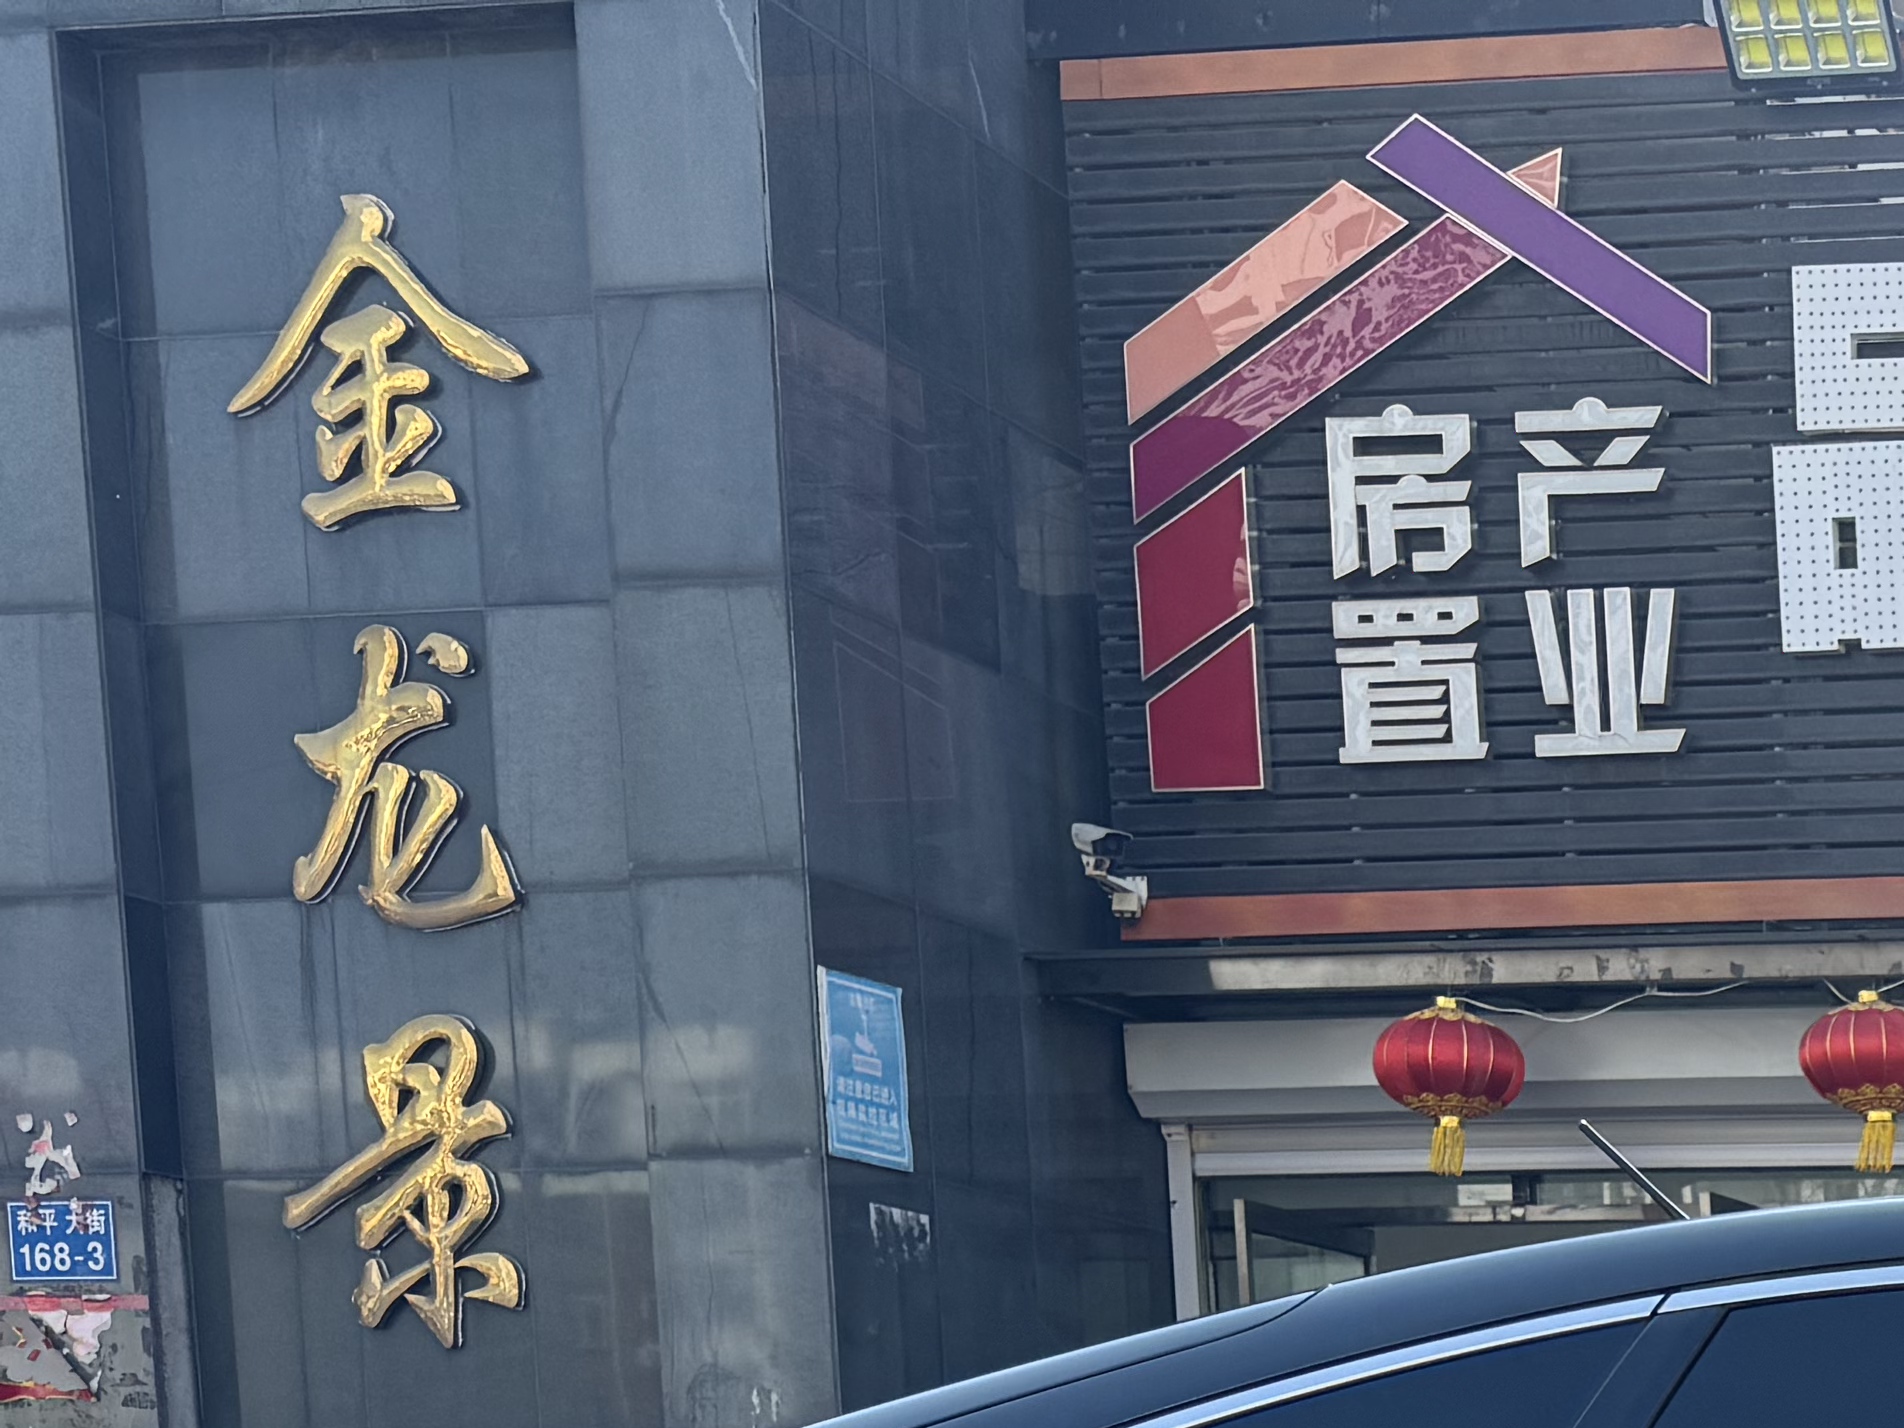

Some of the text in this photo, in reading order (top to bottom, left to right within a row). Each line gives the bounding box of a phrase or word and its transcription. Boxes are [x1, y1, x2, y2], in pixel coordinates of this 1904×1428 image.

[1325, 397, 1666, 580] 房产
[1332, 587, 1687, 764] 置业
[16, 1208, 106, 1236] 和平大街
[19, 1241, 105, 1272] 168-3
